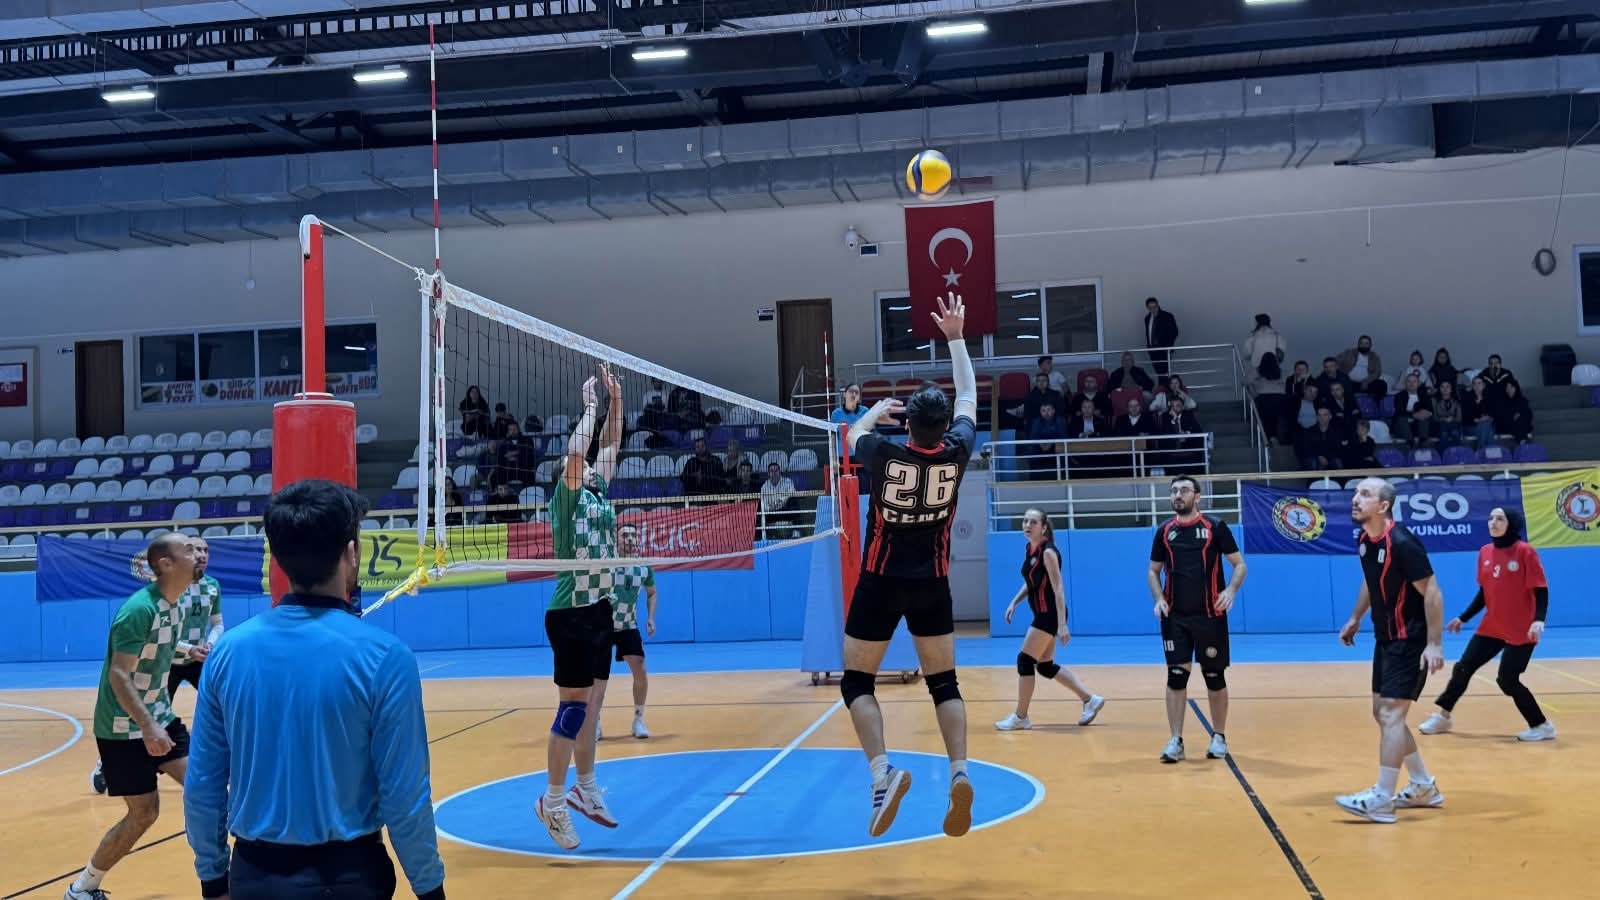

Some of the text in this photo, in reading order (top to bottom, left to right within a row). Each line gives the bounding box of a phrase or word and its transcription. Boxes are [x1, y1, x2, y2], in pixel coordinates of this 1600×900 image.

[881, 459, 958, 508] 26
[1195, 527, 1209, 539] 10
[1407, 523, 1472, 536] YUNLARI
[1377, 548, 1386, 564] 0
[1492, 564, 1502, 578] 3
[191, 602, 203, 617] 23
[1163, 639, 1175, 652] 10
